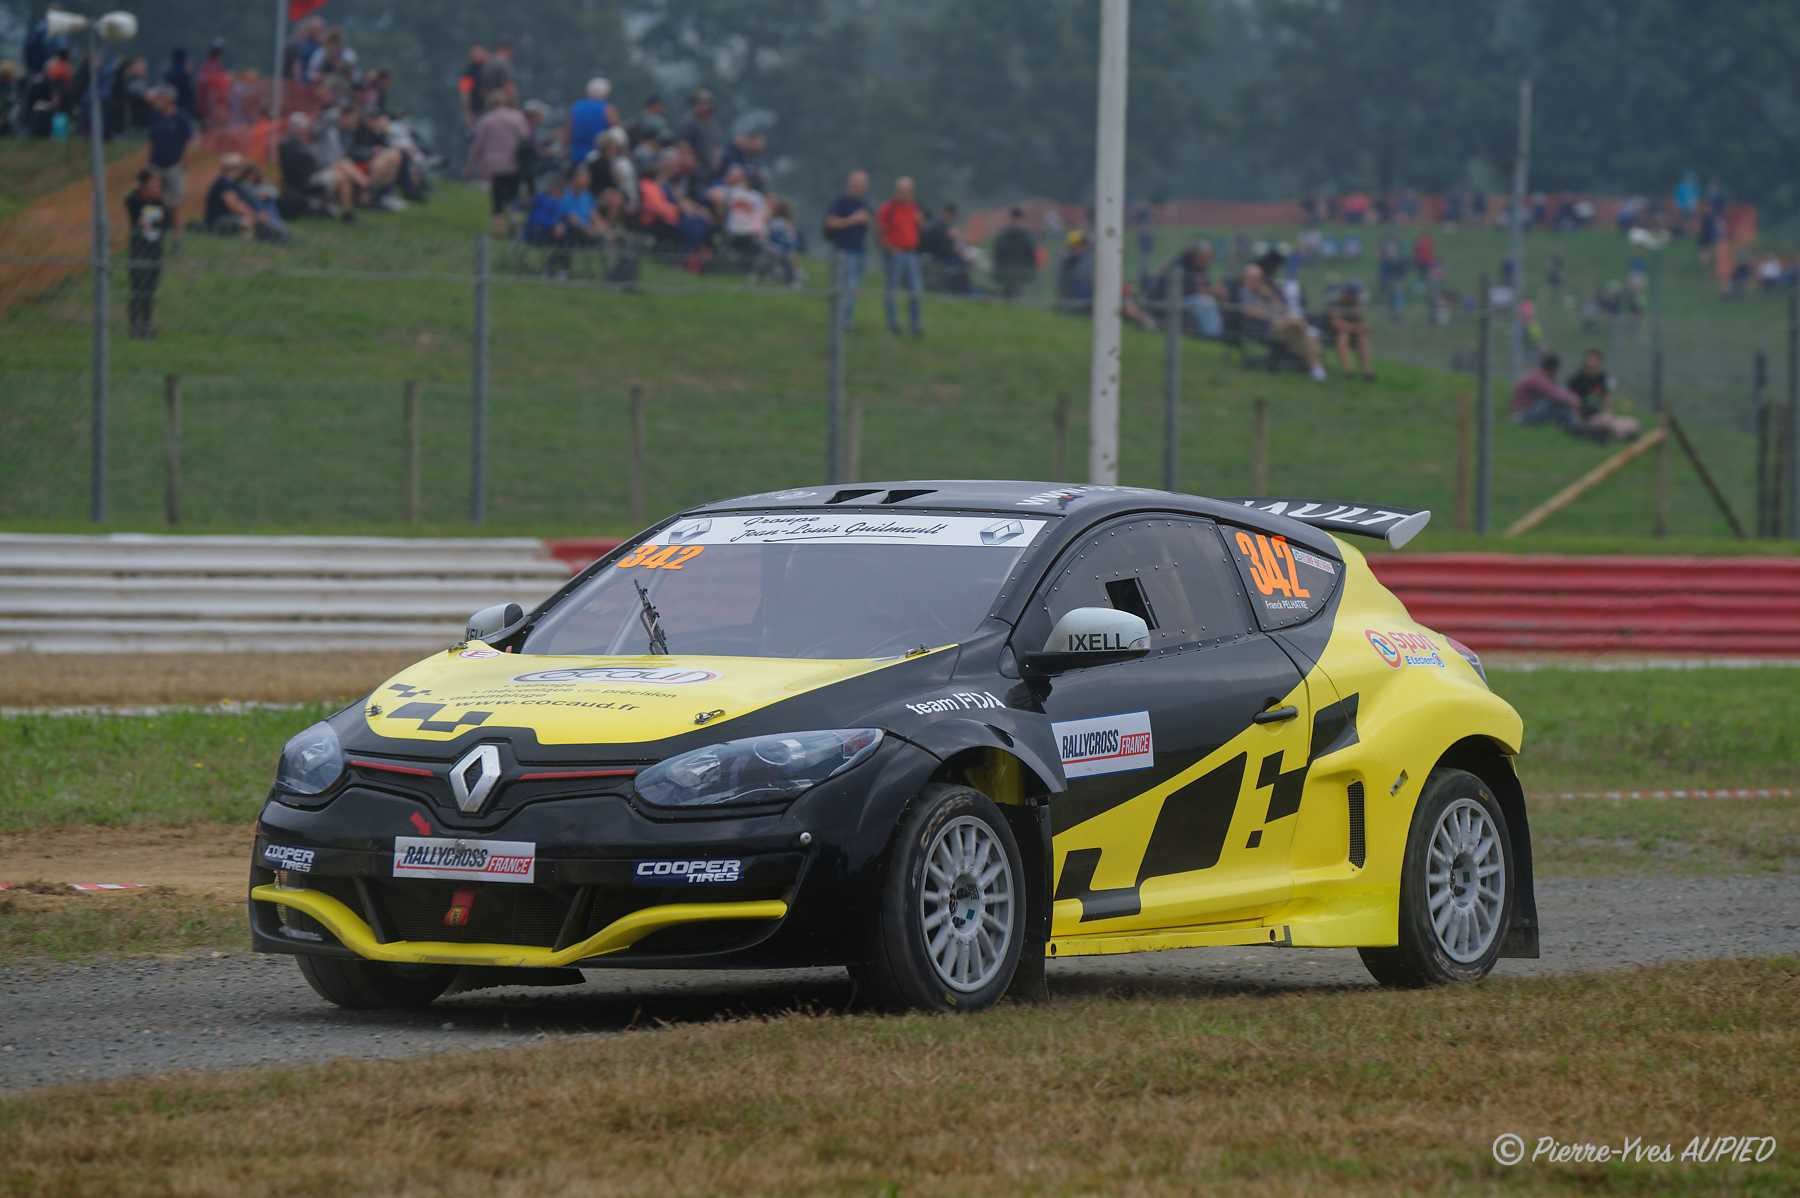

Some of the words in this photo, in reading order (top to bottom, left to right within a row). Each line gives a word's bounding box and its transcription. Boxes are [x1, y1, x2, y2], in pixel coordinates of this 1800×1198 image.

[744, 516, 820, 526] Groupe
[845, 522, 948, 536] Guilmault
[617, 545, 704, 570] 342
[1235, 531, 1311, 599] 342
[1068, 633, 1127, 650] IXELL
[905, 698, 960, 714] team
[1062, 729, 1119, 758] RALLYCROSS
[1120, 734, 1149, 754] FRANCE
[265, 845, 314, 863] COOPER
[403, 846, 488, 867] RALLYCROSS
[487, 857, 531, 873] FRANCE
[281, 860, 312, 872] TIRES
[637, 859, 741, 876] COOPER
[687, 871, 738, 883] TIRES
